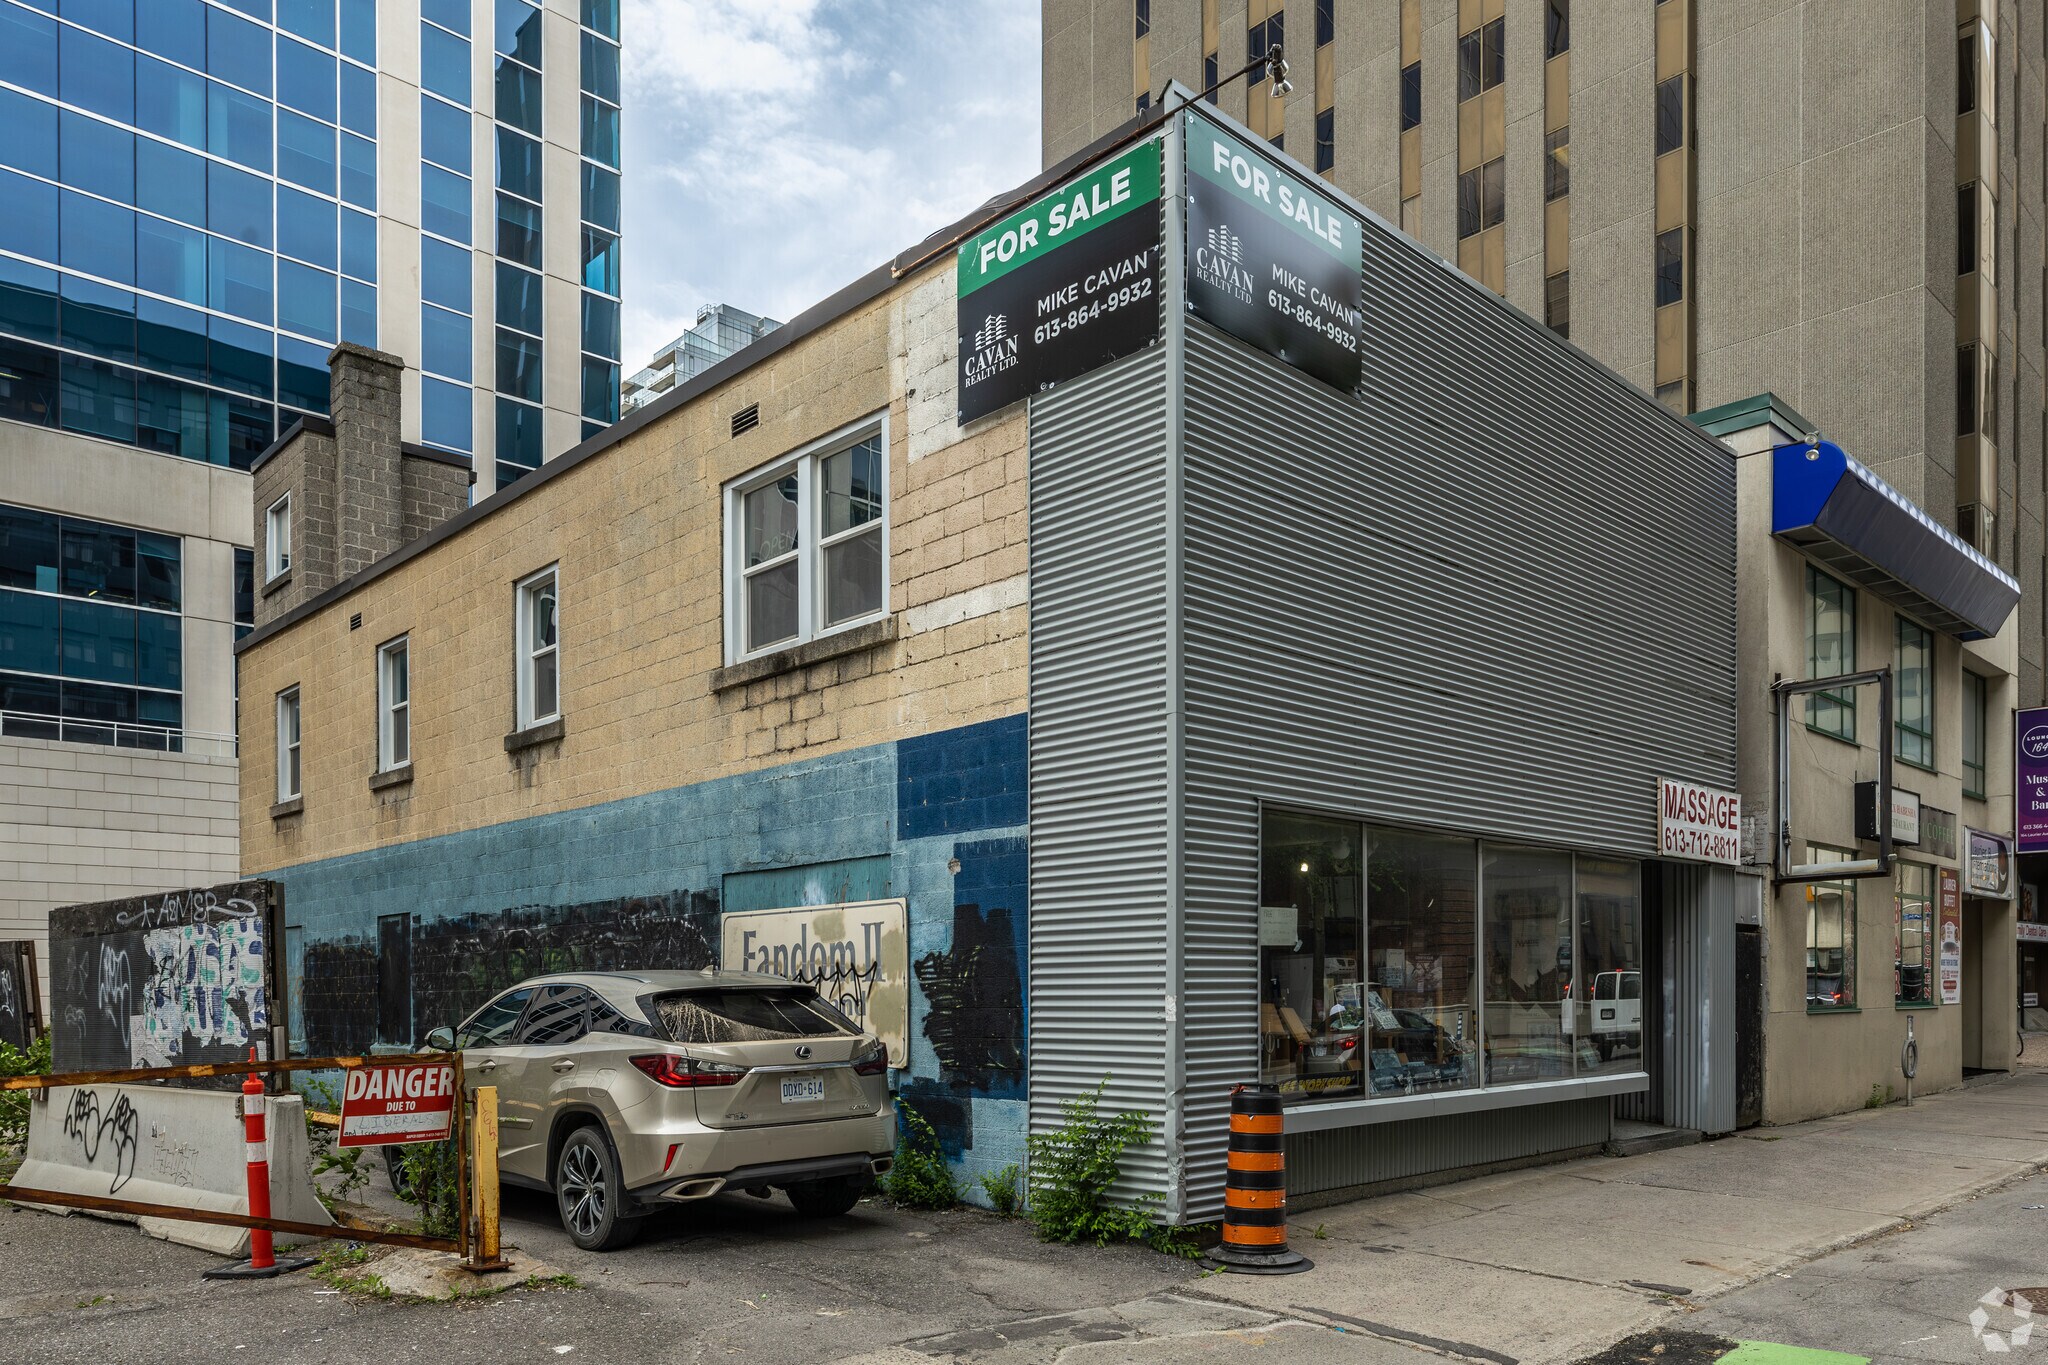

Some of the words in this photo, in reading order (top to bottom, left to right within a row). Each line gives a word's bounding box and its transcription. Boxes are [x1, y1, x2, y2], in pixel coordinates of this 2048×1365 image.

[1213, 140, 1270, 203] FOR
[1278, 185, 1342, 250] SALE
[979, 219, 1040, 274] FOR
[1048, 166, 1131, 236] SALE
[1037, 284, 1078, 316] MIKE
[1084, 252, 1149, 295] CAVAN
[1196, 247, 1254, 294] CAVAN
[1196, 268, 1232, 296] REALTY
[1234, 287, 1254, 306] LTD.
[1034, 277, 1152, 345] 613-864-9932
[1272, 264, 1307, 297] MIKE
[1310, 286, 1354, 326] CAVAN
[1268, 289, 1357, 354] 613-864-9932
[965, 335, 1019, 377] CAVAN
[965, 365, 997, 388] REALTY
[998, 355, 1019, 374] LTD.
[1664, 784, 1738, 830] MASSAGE
[2035, 786, 2047, 797] &
[1665, 827, 1738, 860] 613-712-8811
[1927, 822, 1955, 845] COFFEE
[743, 923, 856, 982] Fandom
[861, 921, 886, 982] II
[1924, 902, 1932, 999] KITCHEN
[2026, 925, 2037, 936] Dental
[346, 1067, 455, 1101] DANGER
[386, 1101, 403, 1112] DUE
[405, 1100, 416, 1111] TO
[1299, 1076, 1352, 1092] WORKSHOP
